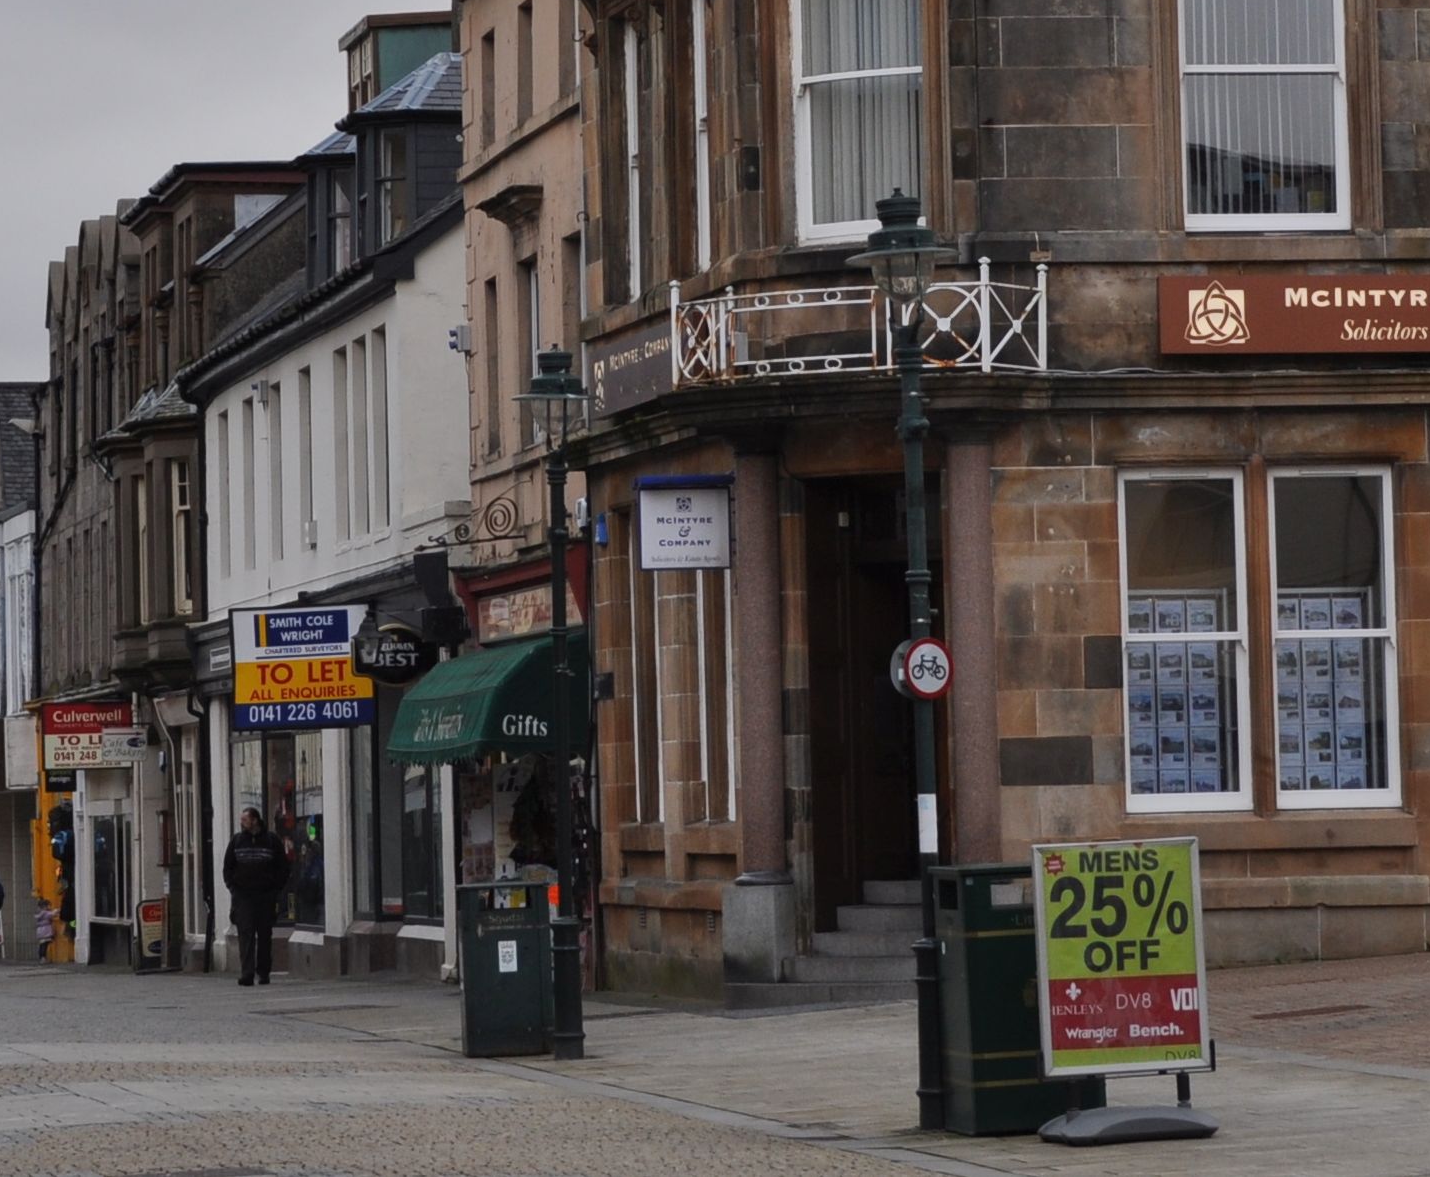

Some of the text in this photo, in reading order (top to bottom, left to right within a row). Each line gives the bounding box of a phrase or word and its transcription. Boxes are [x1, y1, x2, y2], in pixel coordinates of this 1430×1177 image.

[1341, 318, 1428, 341] Solicitors
[678, 525, 692, 538] &
[269, 614, 334, 629] SMITH COLE
[280, 629, 324, 642] WRIGHT
[264, 644, 343, 655] CHARTERED SURVEYORS
[256, 659, 348, 685] TO LET
[249, 684, 357, 701] ALL ENQUIRIES
[52, 709, 122, 723] Culverwell
[249, 701, 359, 723] 0141 226 4061
[502, 713, 548, 737] Gifts
[57, 735, 81, 746] TO
[54, 751, 98, 761] 0141 248
[1079, 849, 1160, 873] MENS
[1050, 871, 1189, 939] 25%
[1083, 939, 1160, 973] OFF
[1115, 992, 1152, 1010] DV8
[1065, 1022, 1184, 1044] Wrangler Bench.
